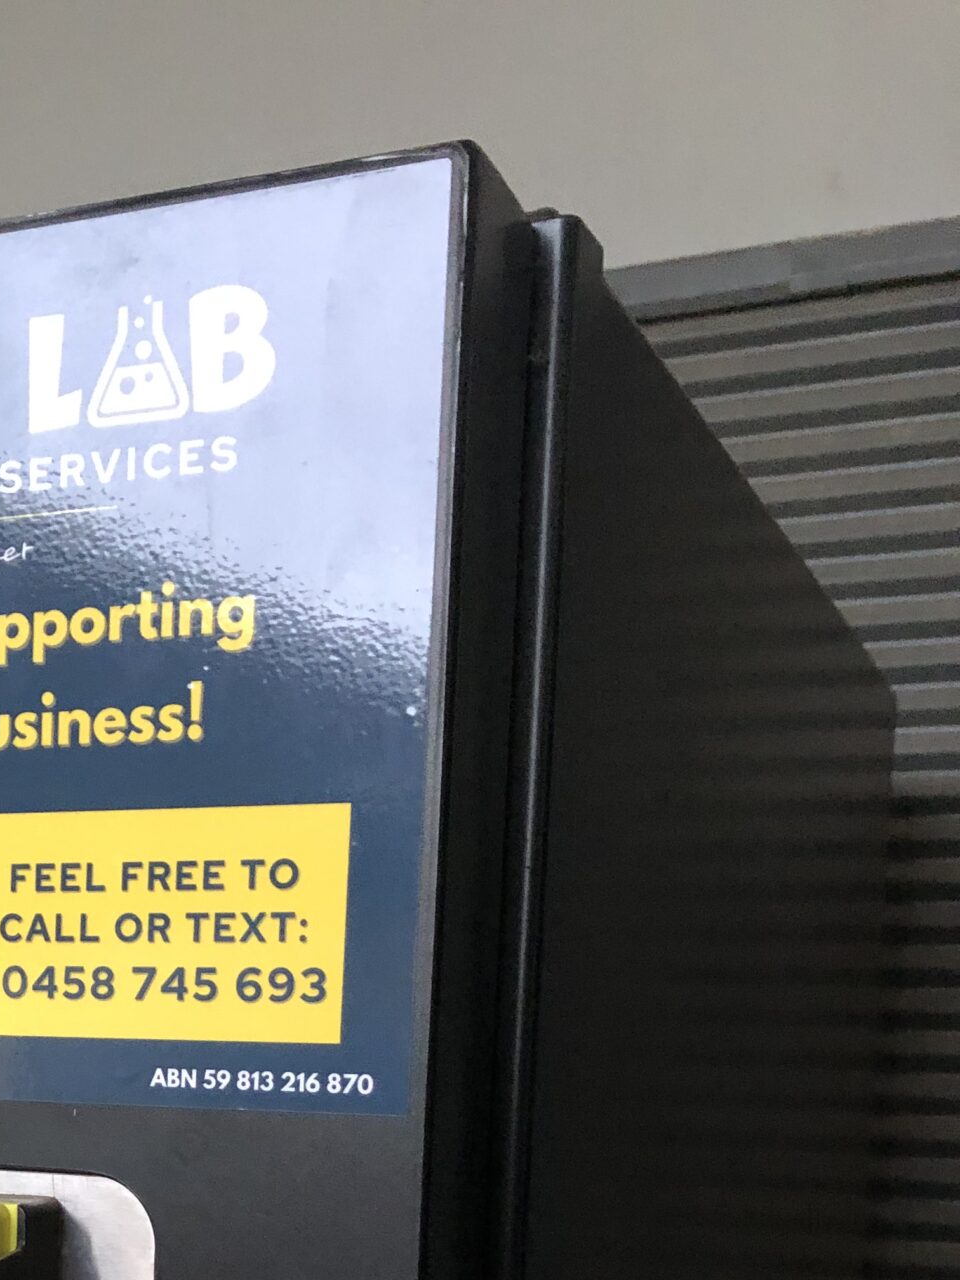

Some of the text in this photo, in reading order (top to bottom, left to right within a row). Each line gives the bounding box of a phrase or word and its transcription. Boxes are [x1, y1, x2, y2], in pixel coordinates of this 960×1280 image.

[9, 858, 300, 893] FEEL FREE TO
[0, 912, 309, 944] CALL OR TEXT:
[2, 965, 328, 1004] 0458 745 693
[150, 1068, 374, 1096] ABN 59 813 216 870
